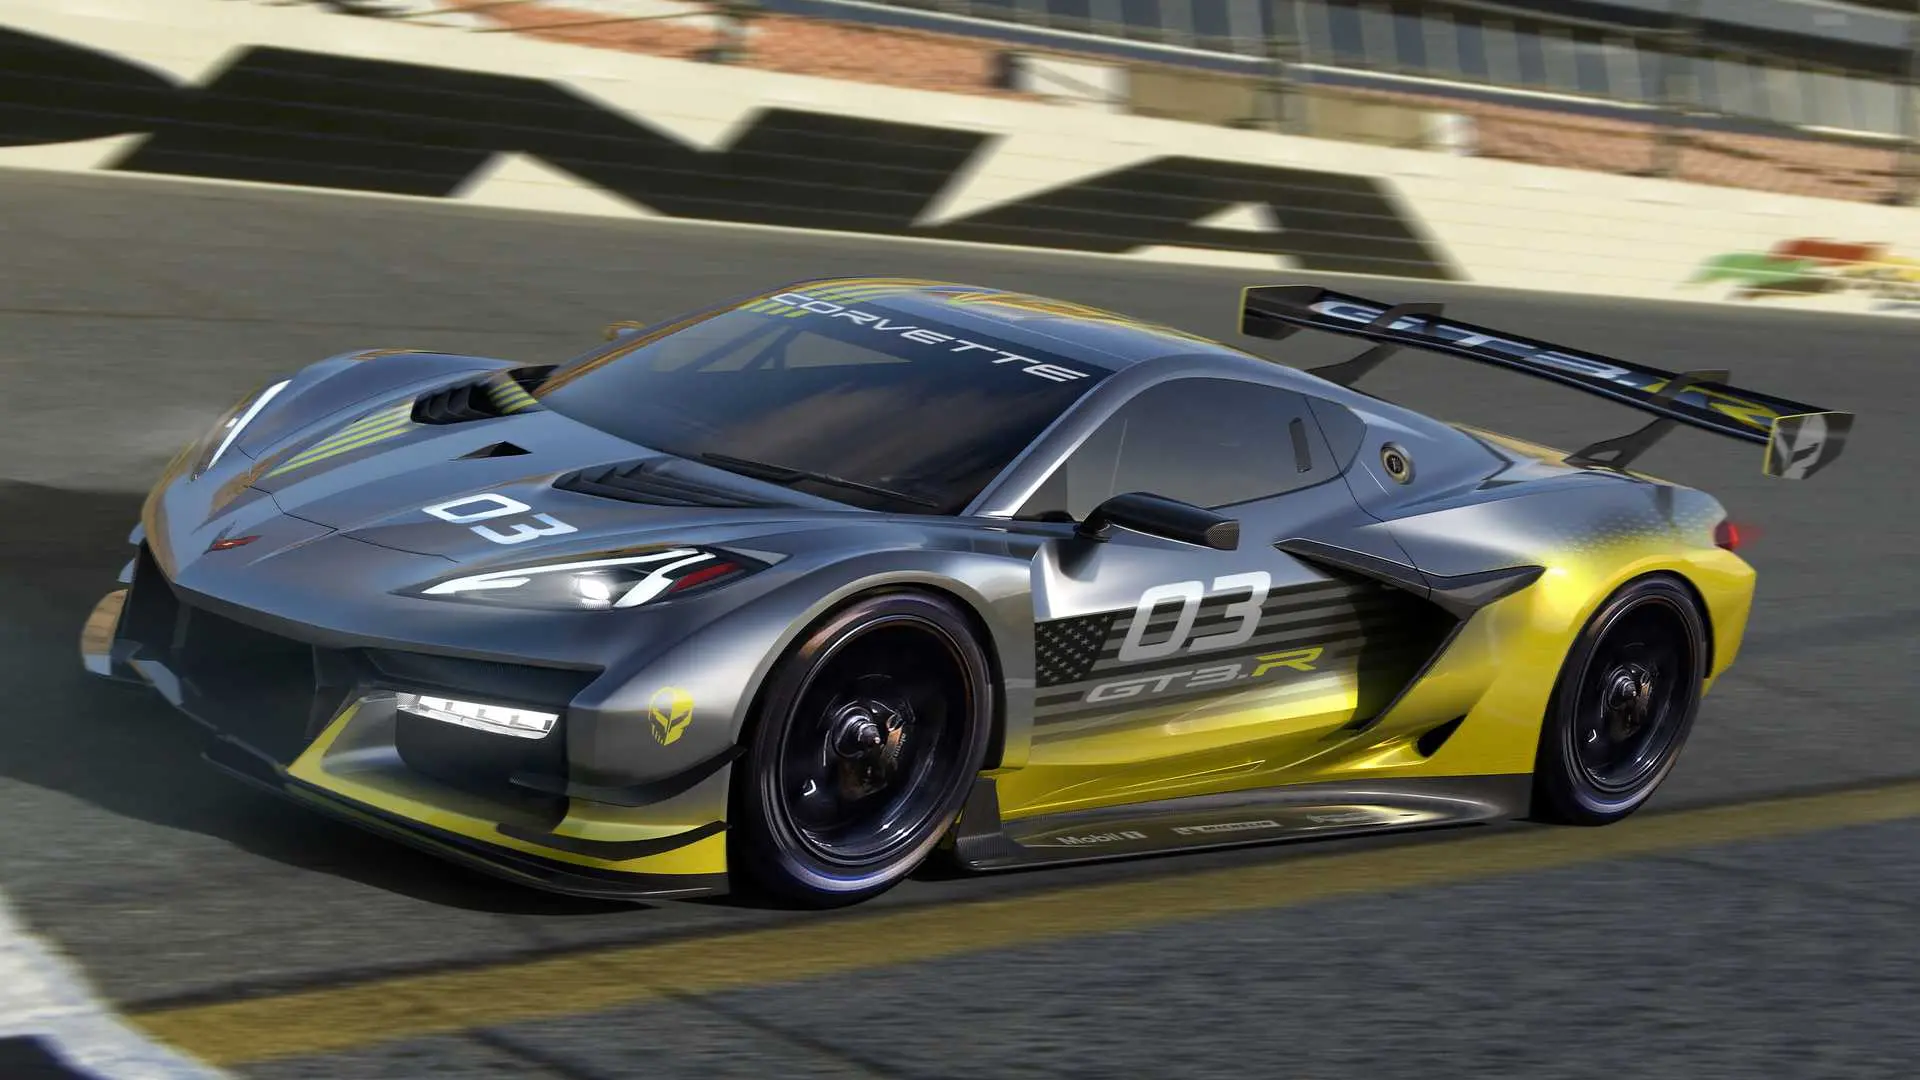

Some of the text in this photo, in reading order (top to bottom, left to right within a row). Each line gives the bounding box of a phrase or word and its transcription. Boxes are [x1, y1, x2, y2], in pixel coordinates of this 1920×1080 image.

[769, 292, 1091, 383] CORVETTE
[421, 492, 579, 545] 03
[1117, 570, 1272, 662] 03
[1085, 646, 1324, 703] GT3.R
[1056, 832, 1125, 845] Mobil
